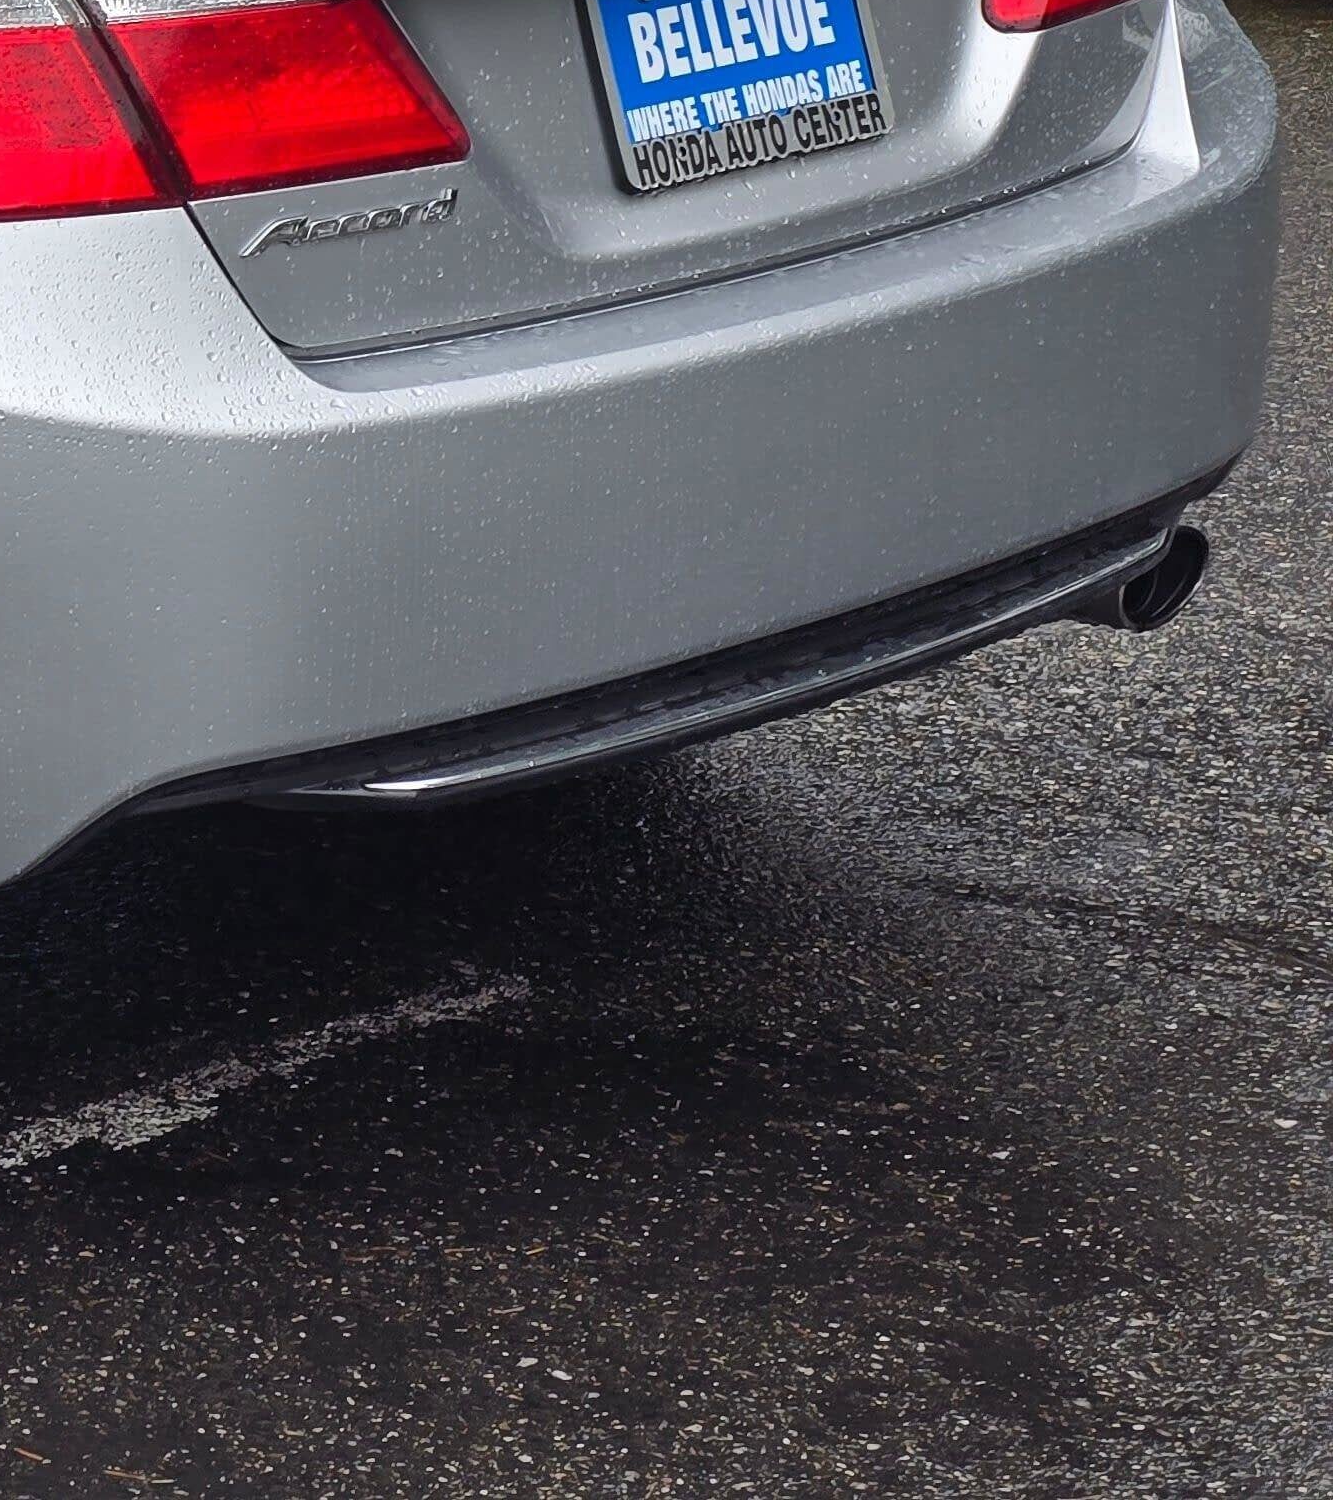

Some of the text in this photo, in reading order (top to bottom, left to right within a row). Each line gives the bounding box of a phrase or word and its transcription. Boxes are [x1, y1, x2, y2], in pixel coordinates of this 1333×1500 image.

[627, 60, 866, 142] WHERE THE HONDAS ARE
[633, 94, 887, 188] HONDA AUTO CENTER
[239, 189, 458, 258] Accord
